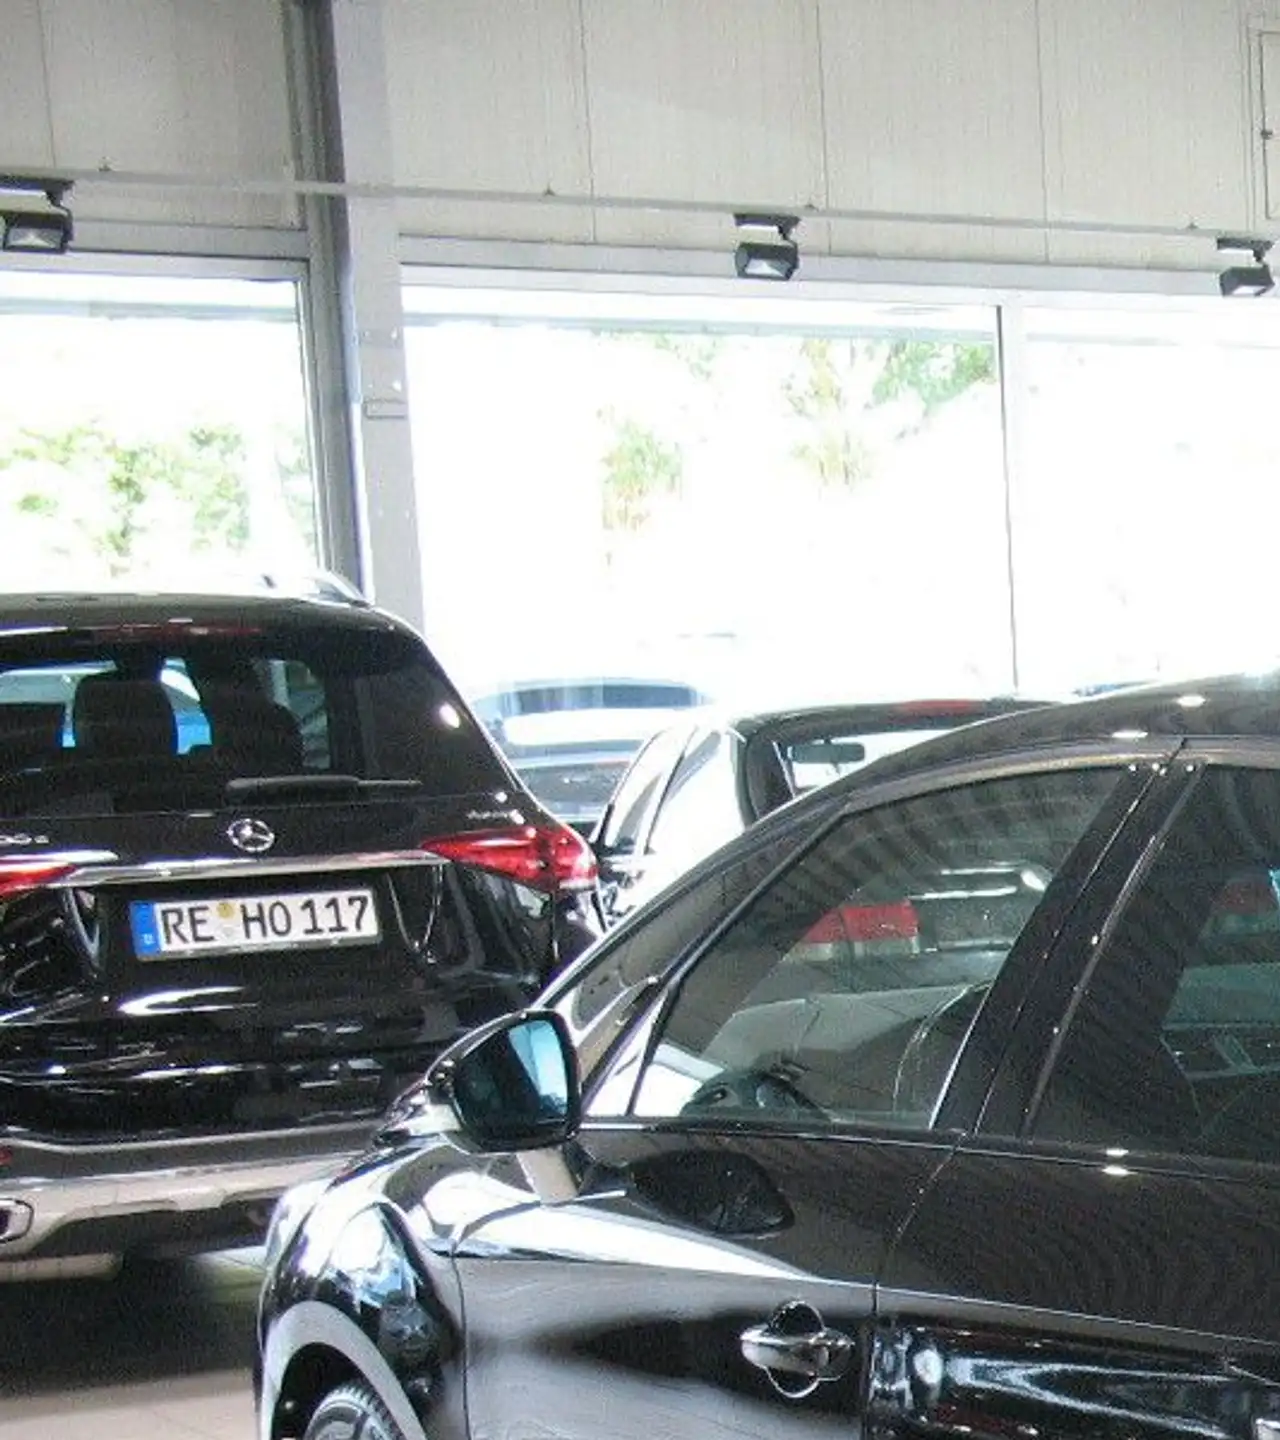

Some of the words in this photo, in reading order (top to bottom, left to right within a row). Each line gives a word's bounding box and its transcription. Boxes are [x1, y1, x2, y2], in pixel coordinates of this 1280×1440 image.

[161, 906, 215, 944] RE
[241, 900, 291, 939] HO
[300, 895, 369, 935] 117
